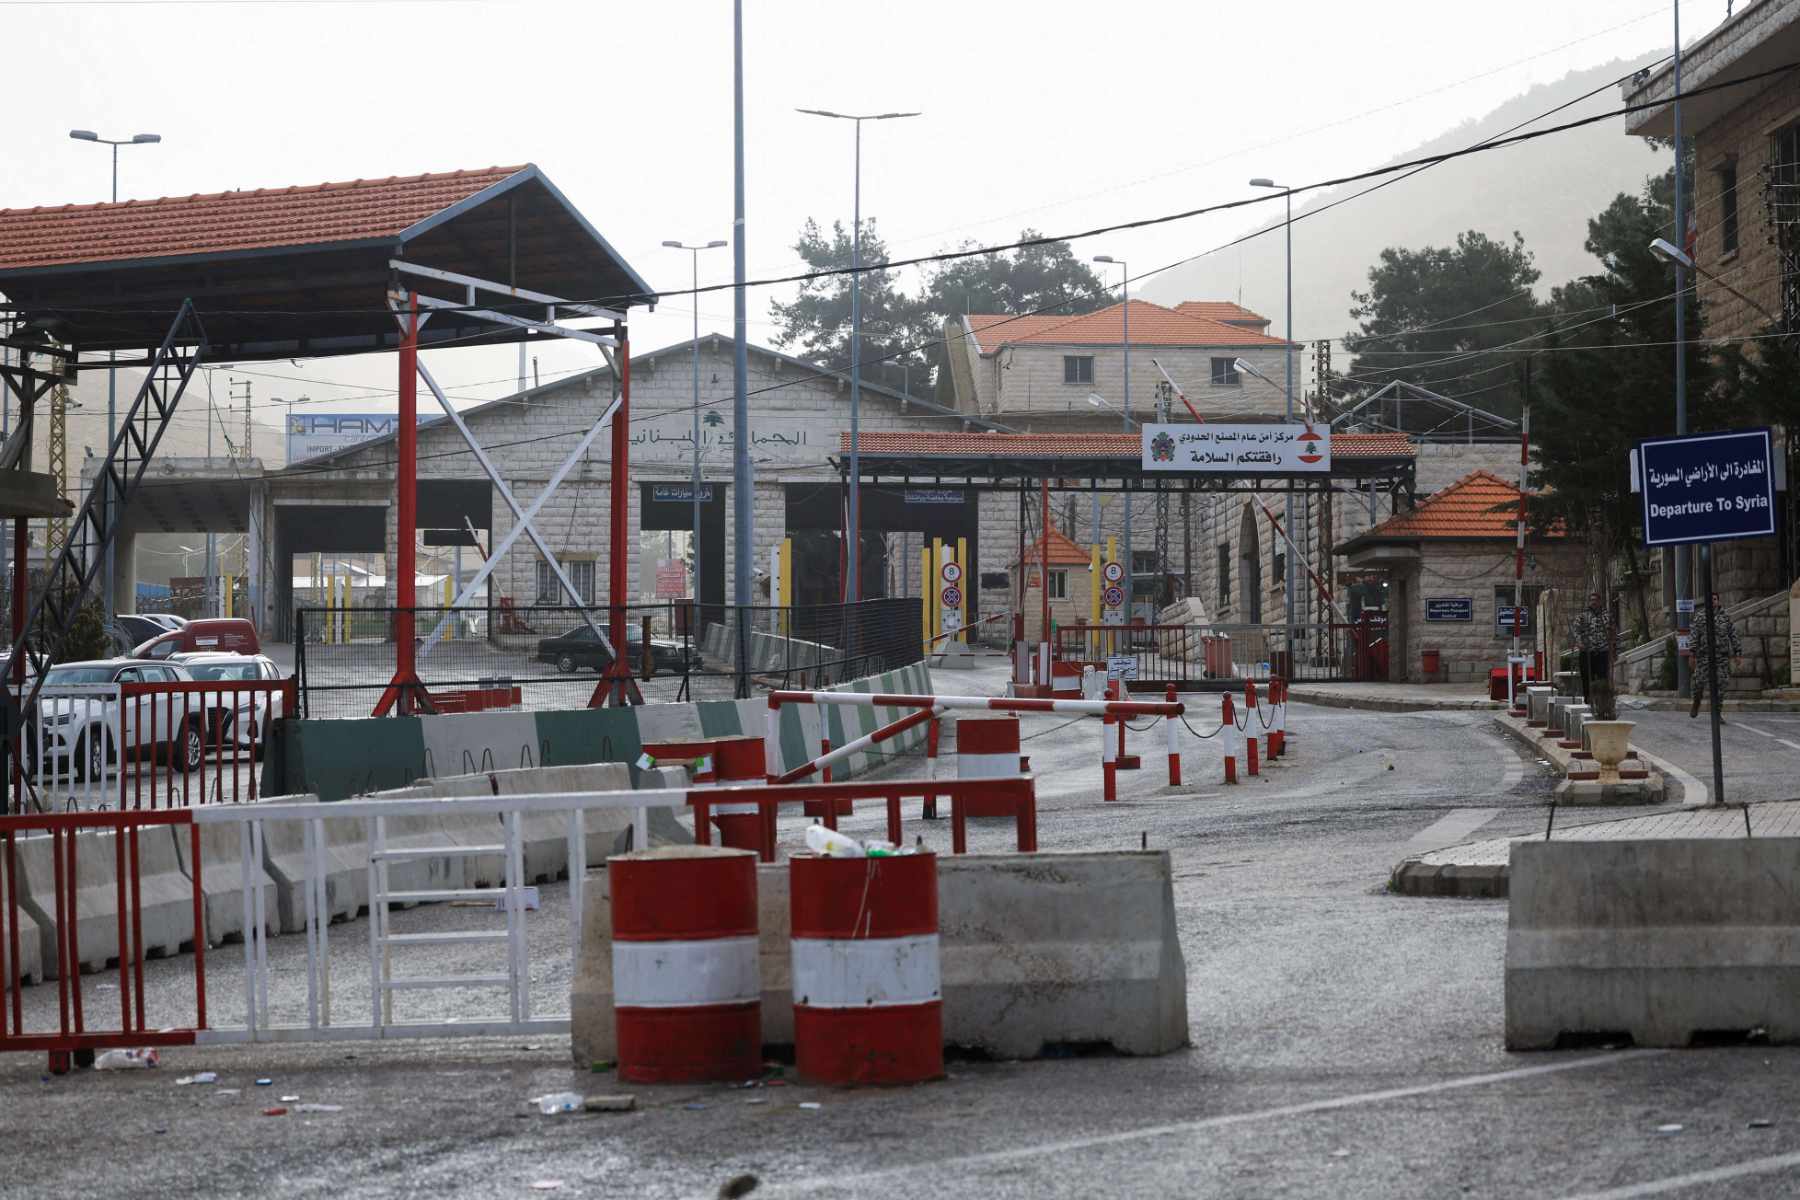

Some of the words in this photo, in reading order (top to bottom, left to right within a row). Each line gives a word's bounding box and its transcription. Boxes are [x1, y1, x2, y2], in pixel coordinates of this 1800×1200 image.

[1179, 432, 1214, 444] الحدودي
[1215, 432, 1240, 445] المصنع
[1241, 433, 1257, 444] عام
[1274, 432, 1294, 443] مركز
[1190, 450, 1234, 464] السلامة
[1236, 451, 1282, 465] رافقتكم
[1685, 461, 1718, 488] الأراضي
[1733, 459, 1765, 480] المغادرة
[1648, 467, 1683, 488] السورية
[1650, 500, 1713, 519] Departure
[1716, 497, 1732, 512] To
[1735, 494, 1768, 512] Syria
